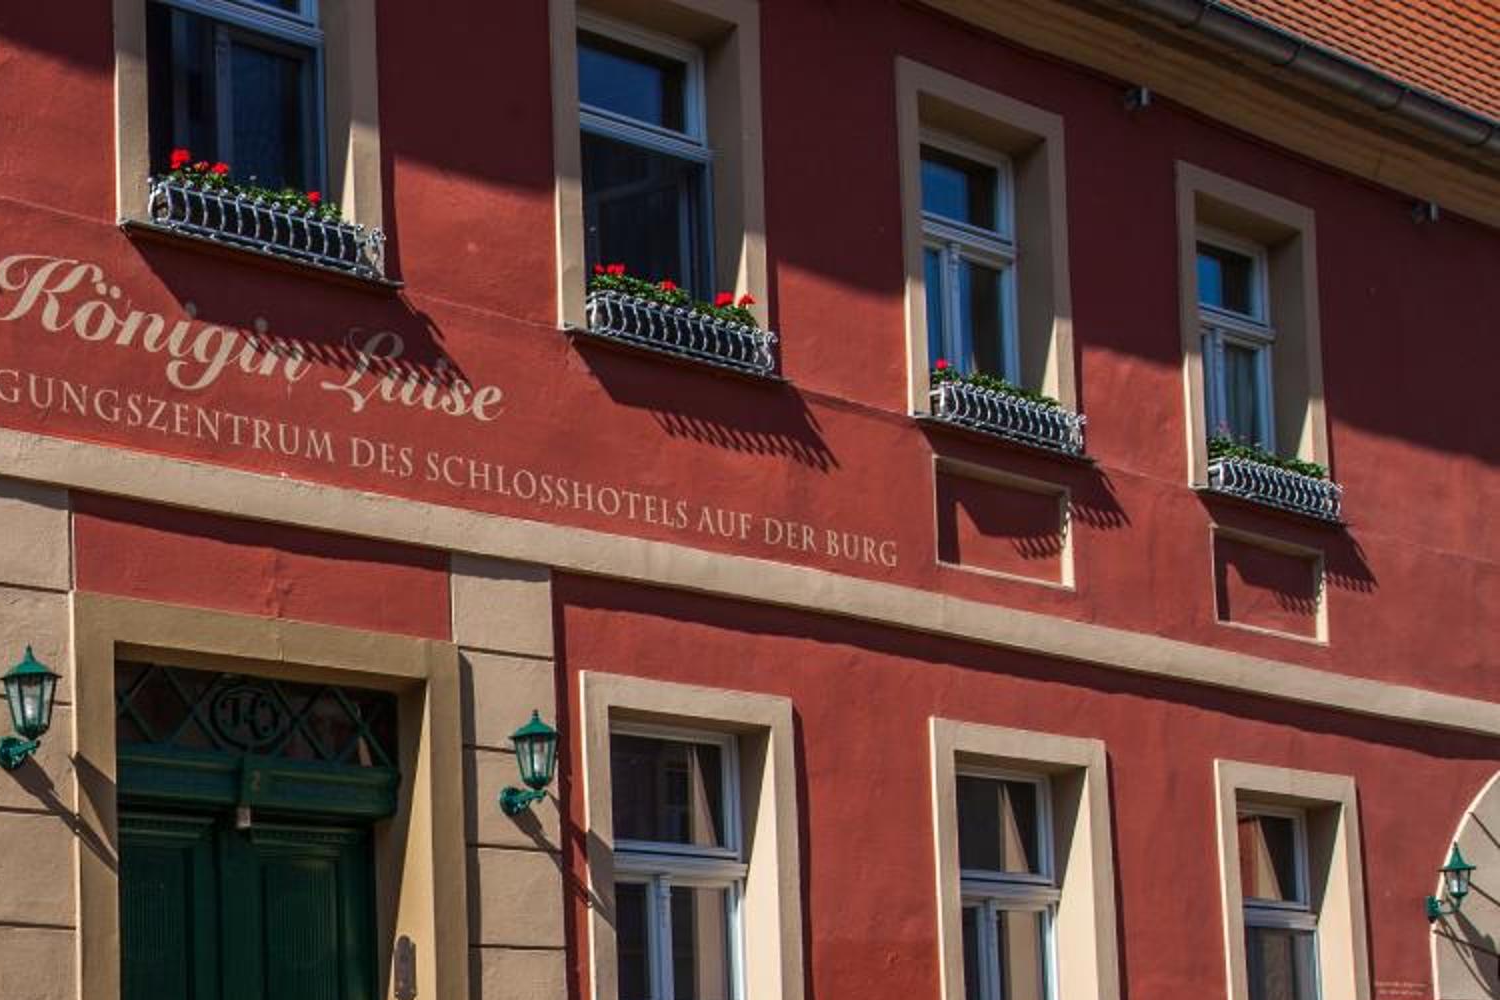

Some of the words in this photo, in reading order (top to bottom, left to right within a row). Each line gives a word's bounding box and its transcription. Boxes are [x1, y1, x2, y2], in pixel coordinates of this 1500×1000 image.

[321, 325, 505, 422] Luise
[350, 437, 413, 477] DES
[426, 452, 688, 529] SCHLOSSHOTELS
[698, 508, 752, 540] AUF
[763, 517, 815, 553] DER
[827, 529, 898, 569] BURG
